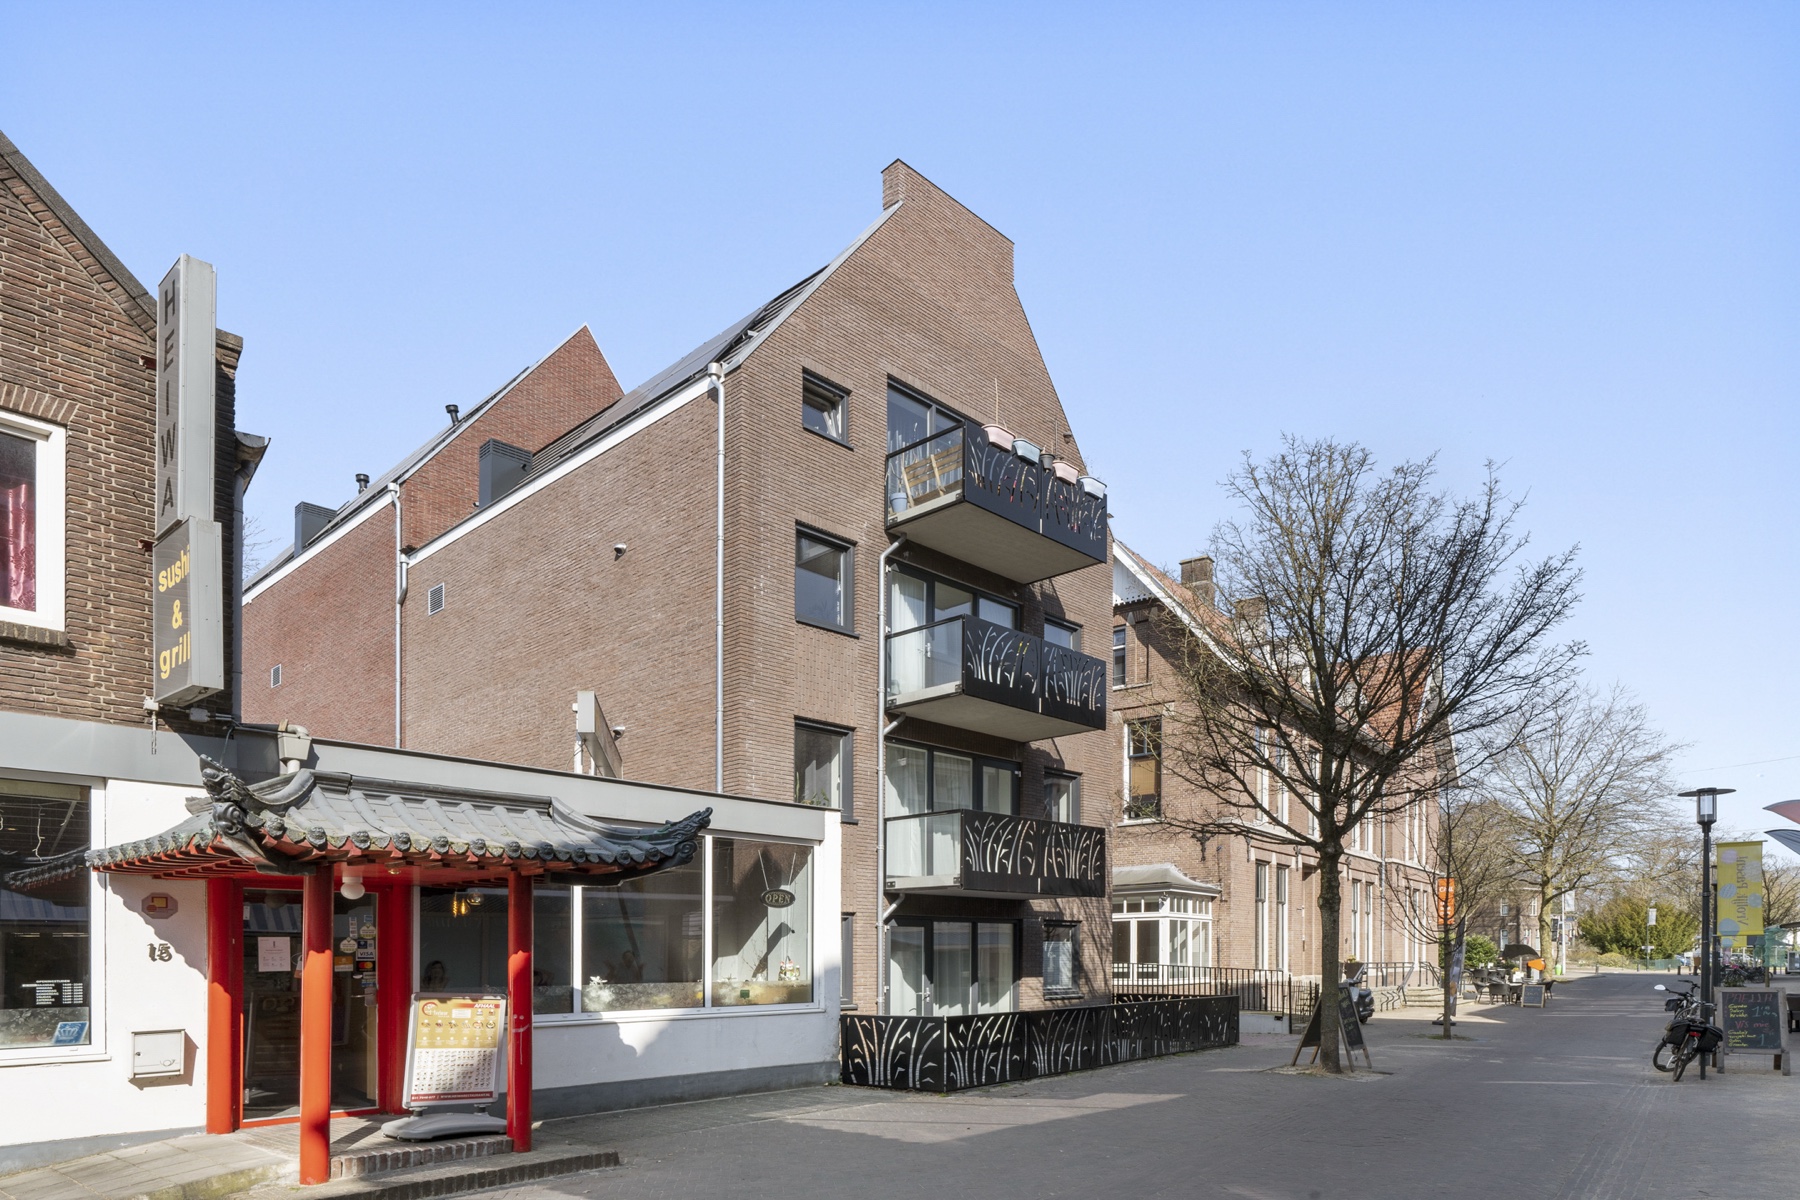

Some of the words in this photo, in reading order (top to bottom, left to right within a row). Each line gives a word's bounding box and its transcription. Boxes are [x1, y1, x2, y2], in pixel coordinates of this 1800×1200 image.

[161, 279, 176, 518] HEIWA
[158, 545, 190, 593] sushi
[171, 599, 183, 630] &
[159, 631, 191, 680] grill
[765, 893, 790, 903] OPEN
[147, 943, 173, 962] 15
